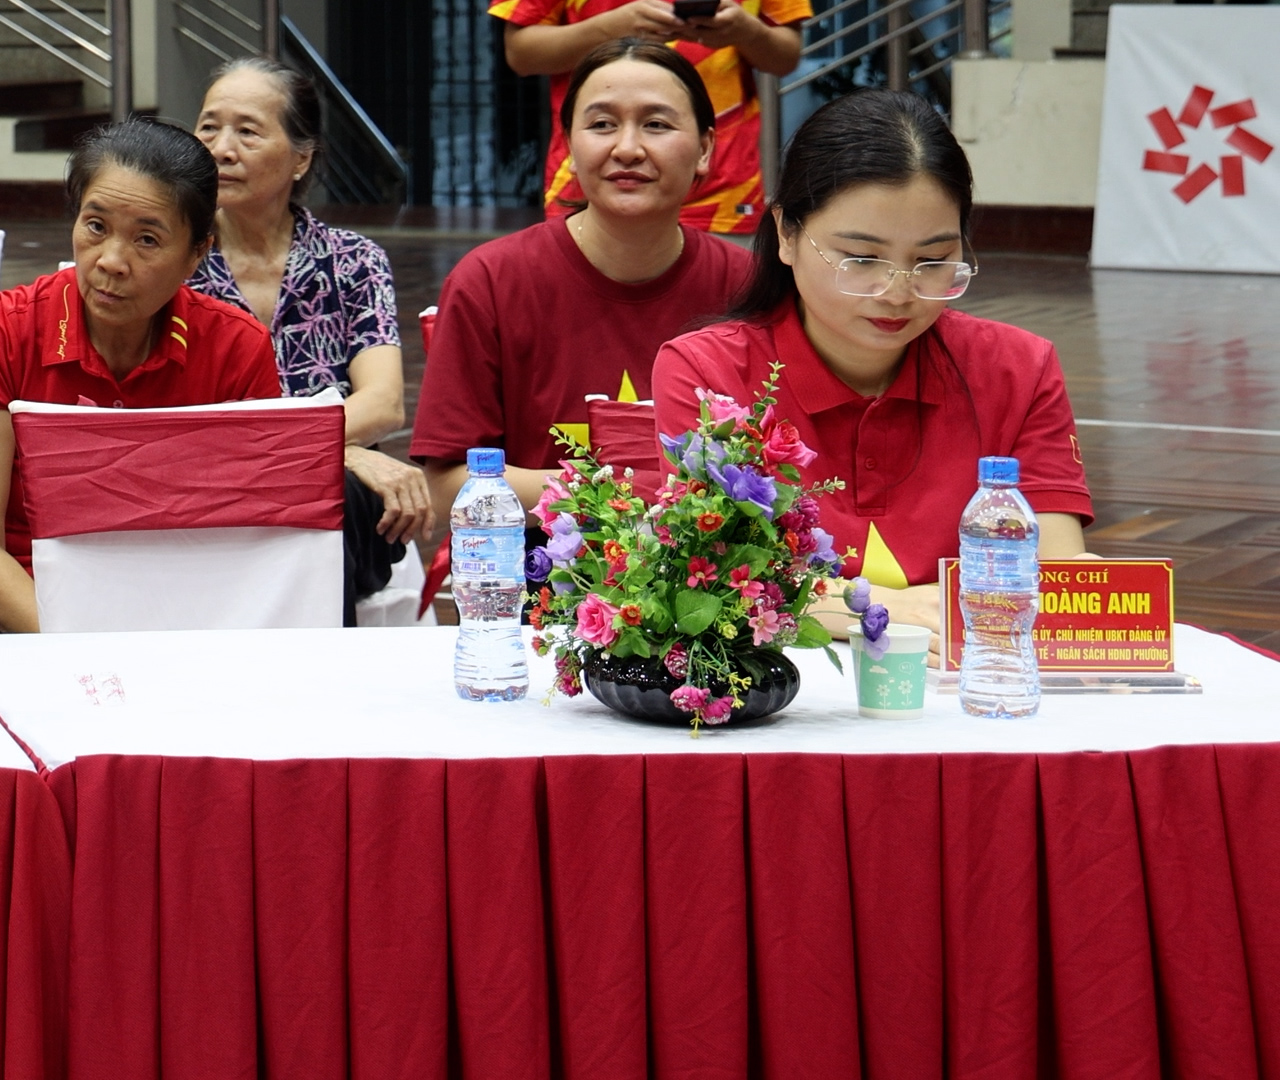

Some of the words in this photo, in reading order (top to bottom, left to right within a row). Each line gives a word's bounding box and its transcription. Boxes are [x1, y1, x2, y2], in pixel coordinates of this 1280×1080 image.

[1076, 568, 1108, 583] CHÍ
[1107, 593, 1150, 614] ANH
[1055, 626, 1074, 641] CHỦ
[1075, 628, 1103, 643] NHIỆM
[1105, 630, 1127, 642] UBKT
[1129, 626, 1153, 642] ĐẢNG
[1153, 627, 1166, 642] ỦY
[1039, 646, 1049, 660] TẾ
[1056, 647, 1082, 660] NGÂN
[1082, 648, 1107, 660] SÁCH
[1108, 648, 1132, 660] HĐND
[1133, 647, 1169, 662] PHƯỜNG
